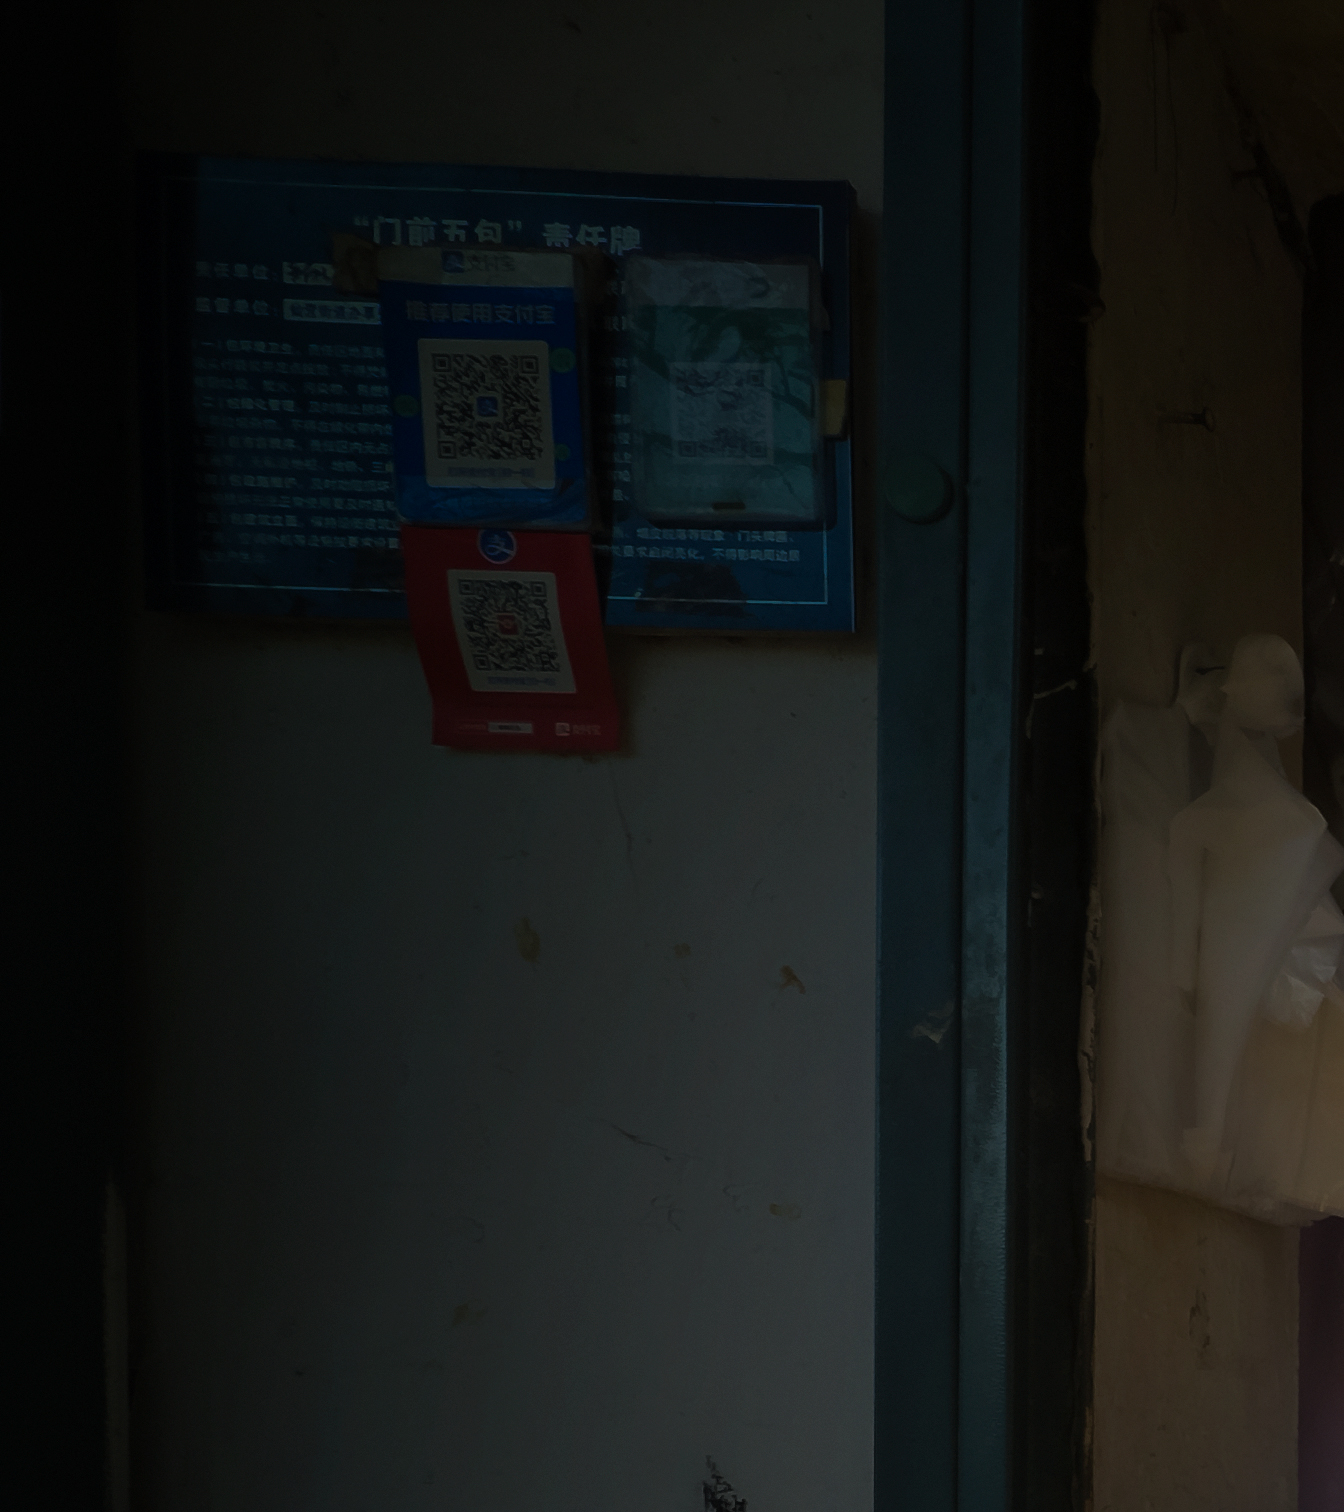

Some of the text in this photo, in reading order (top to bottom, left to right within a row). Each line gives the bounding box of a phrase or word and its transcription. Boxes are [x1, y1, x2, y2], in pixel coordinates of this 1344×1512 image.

[406, 299, 557, 325] 推荐使用支付宝
